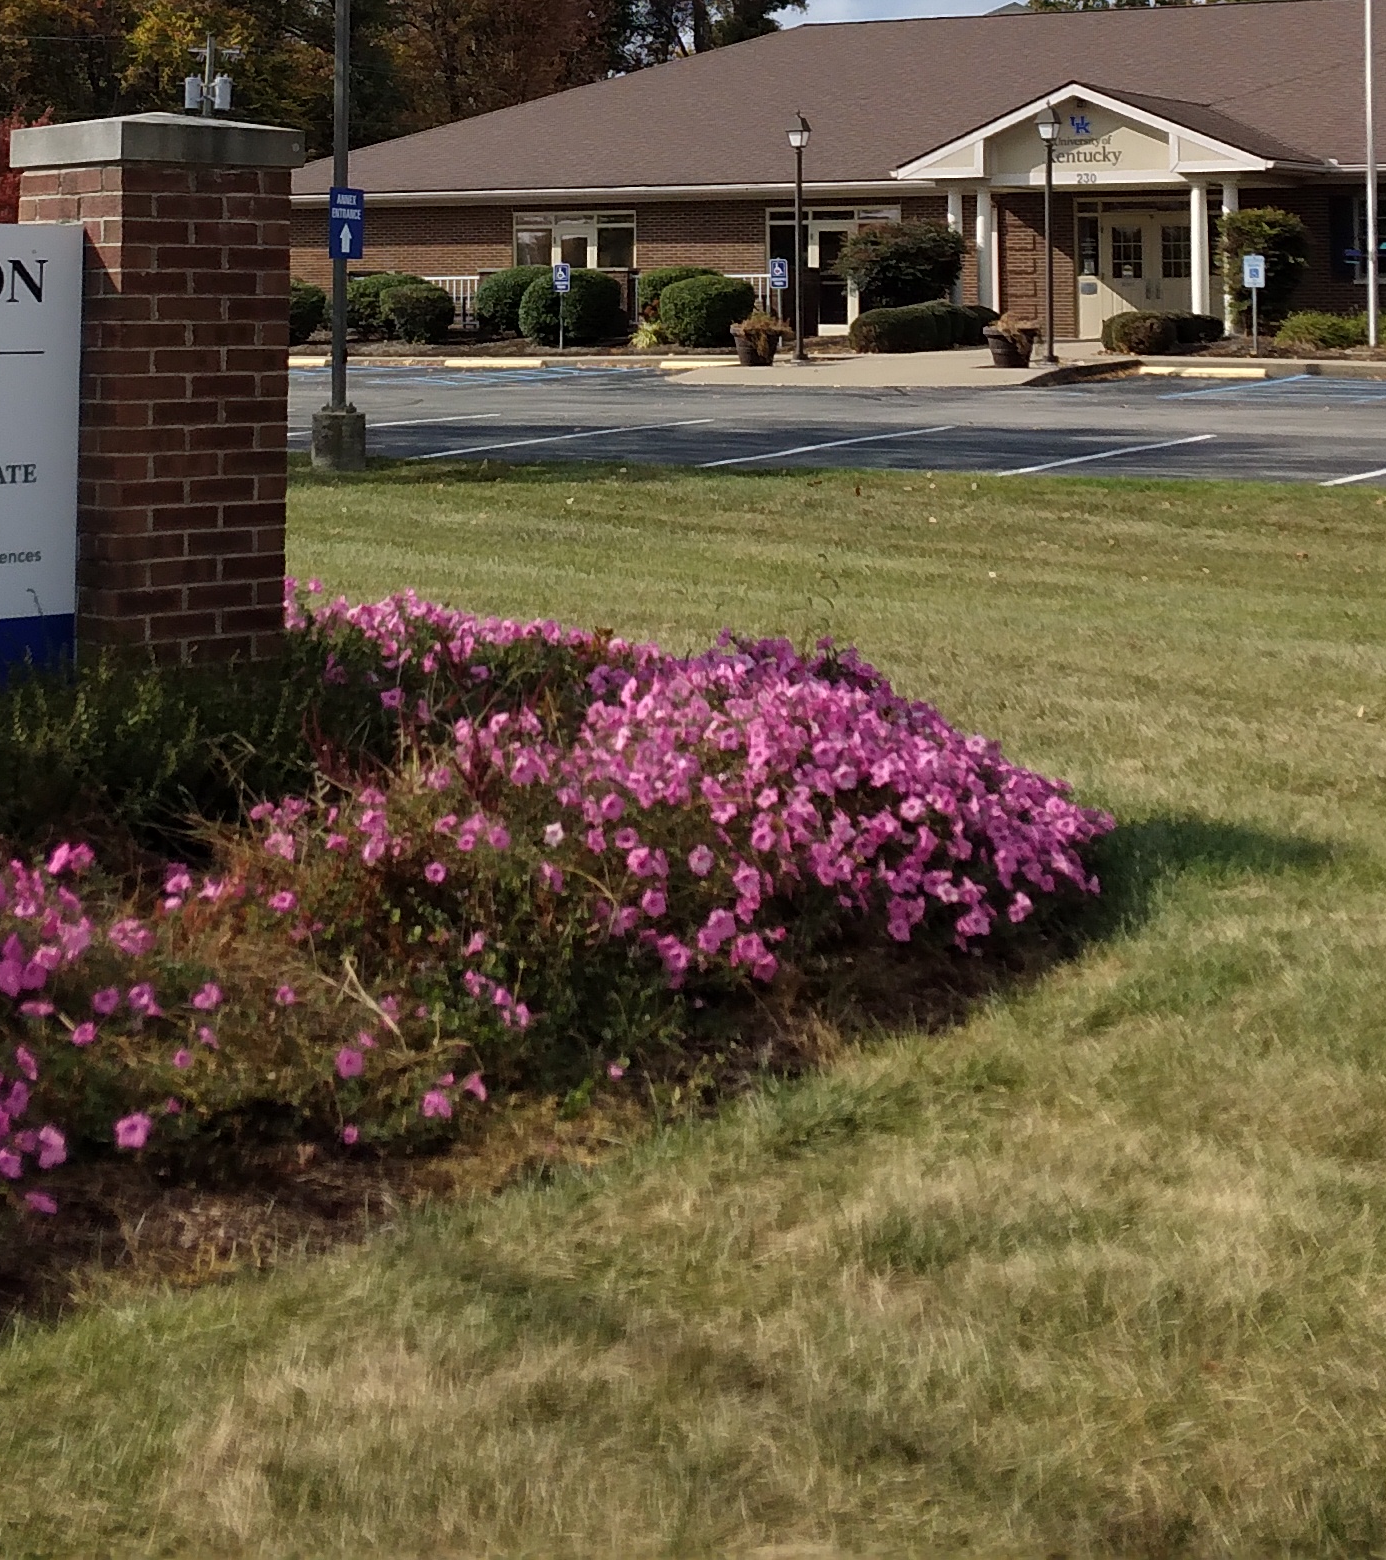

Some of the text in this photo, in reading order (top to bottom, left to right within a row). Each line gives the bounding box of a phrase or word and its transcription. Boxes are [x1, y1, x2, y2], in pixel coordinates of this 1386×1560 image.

[1069, 115, 1091, 134] UK
[1101, 134, 1113, 145] of
[1076, 172, 1098, 184] 230
[336, 193, 357, 206] ANNEX
[331, 207, 362, 220] ENTRANCE
